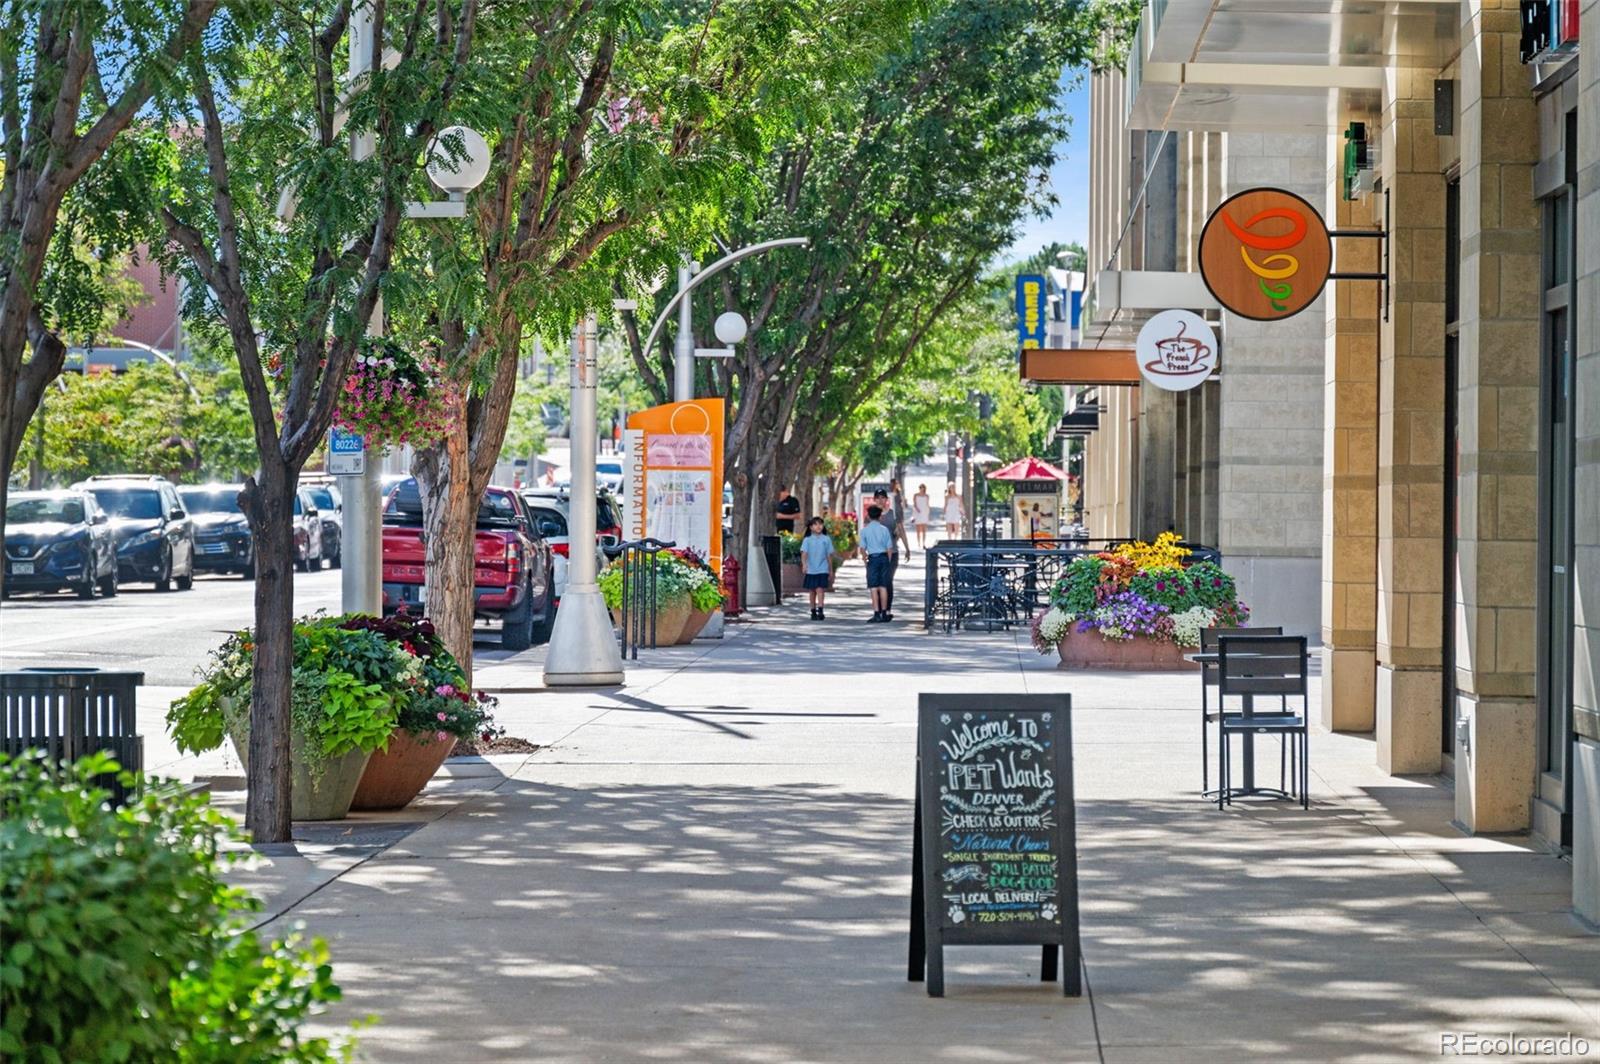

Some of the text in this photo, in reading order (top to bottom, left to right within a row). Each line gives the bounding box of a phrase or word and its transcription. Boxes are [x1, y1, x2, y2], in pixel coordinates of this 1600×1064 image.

[1024, 281, 1039, 336] BEST
[1171, 343, 1186, 353] The
[939, 720, 1015, 760] Welcome
[948, 751, 1054, 790] PET Wants
[972, 792, 1025, 806] DENVER
[953, 814, 987, 828] CHECK
[961, 892, 992, 905] LOCAL
